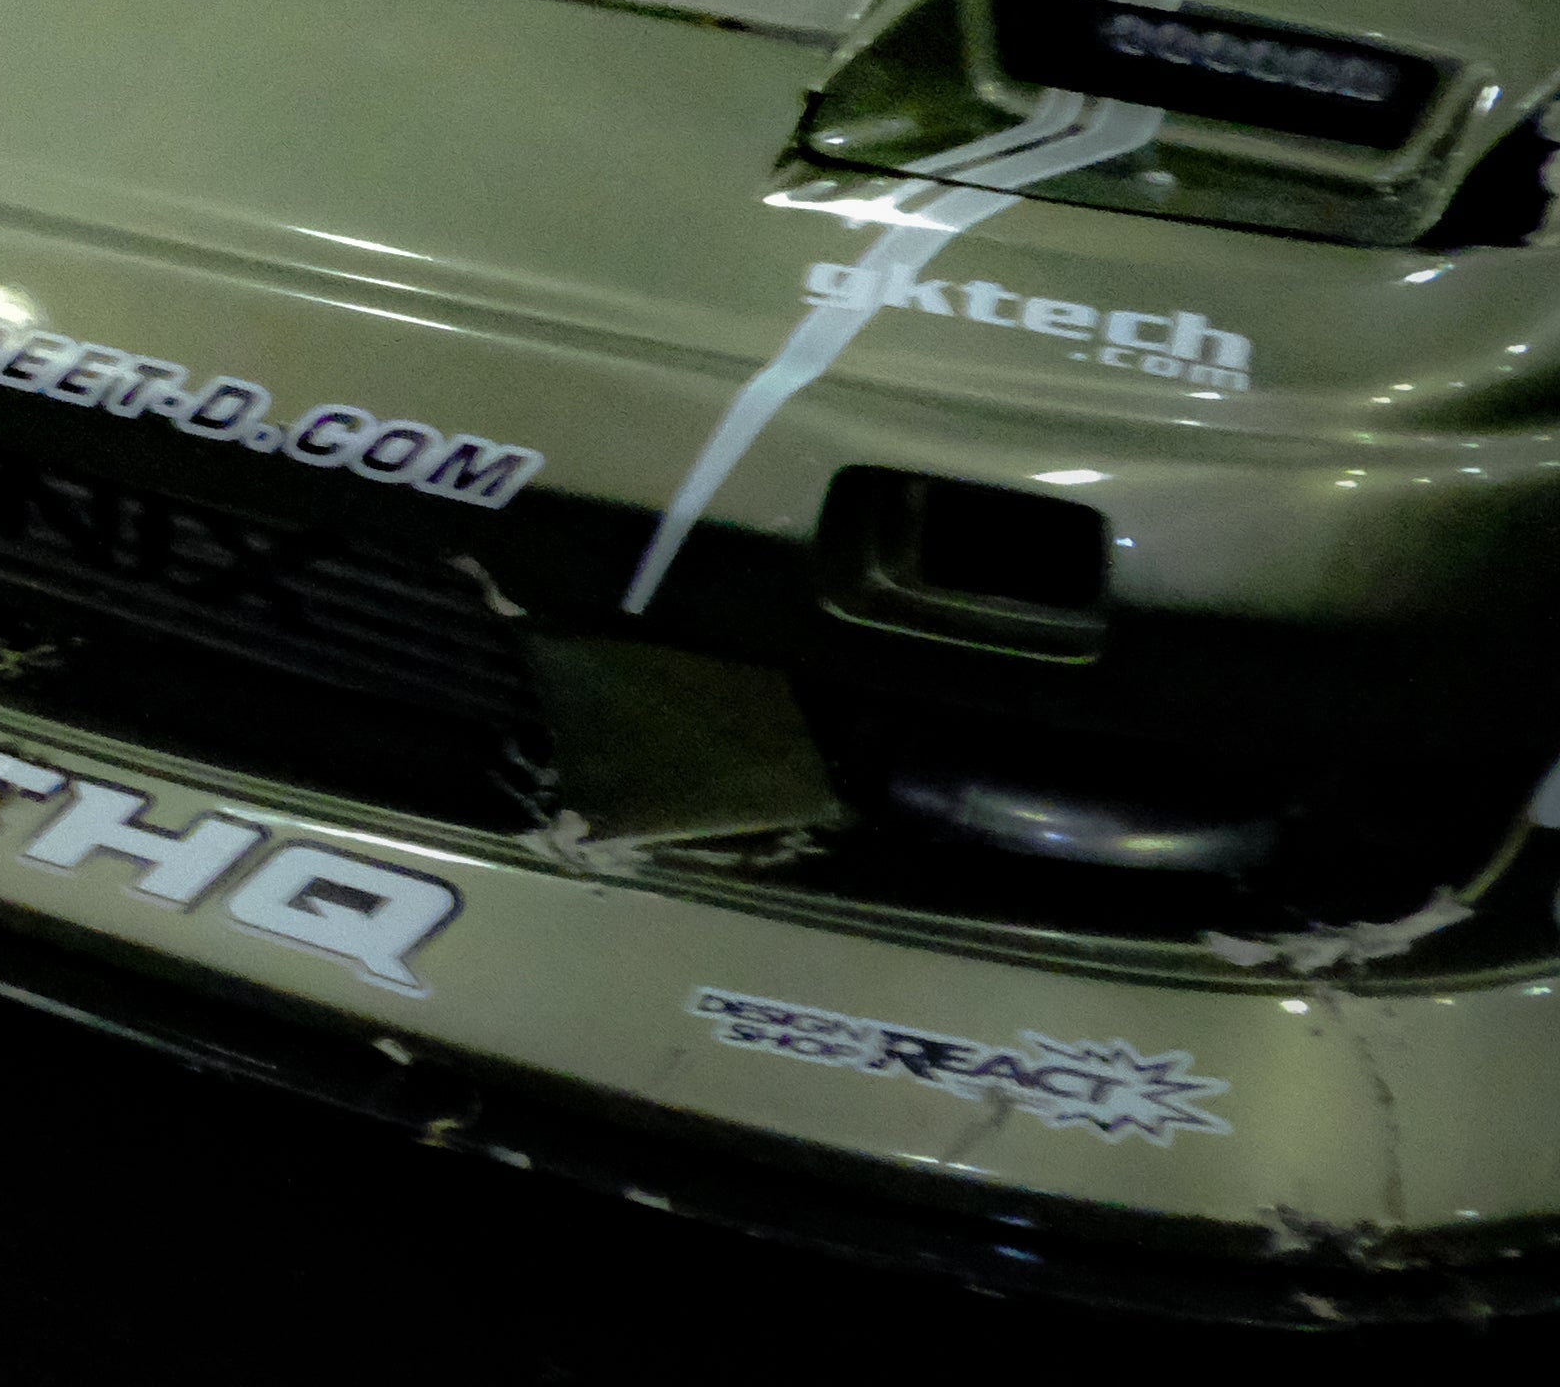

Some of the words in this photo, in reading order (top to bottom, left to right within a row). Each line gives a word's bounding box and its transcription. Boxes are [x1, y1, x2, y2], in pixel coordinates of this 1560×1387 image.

[802, 261, 1253, 371] gktech
[1068, 341, 1250, 393] .com
[702, 991, 874, 1042] DESIGN
[726, 1023, 861, 1066] SHOP
[869, 1029, 1130, 1107] REACT
